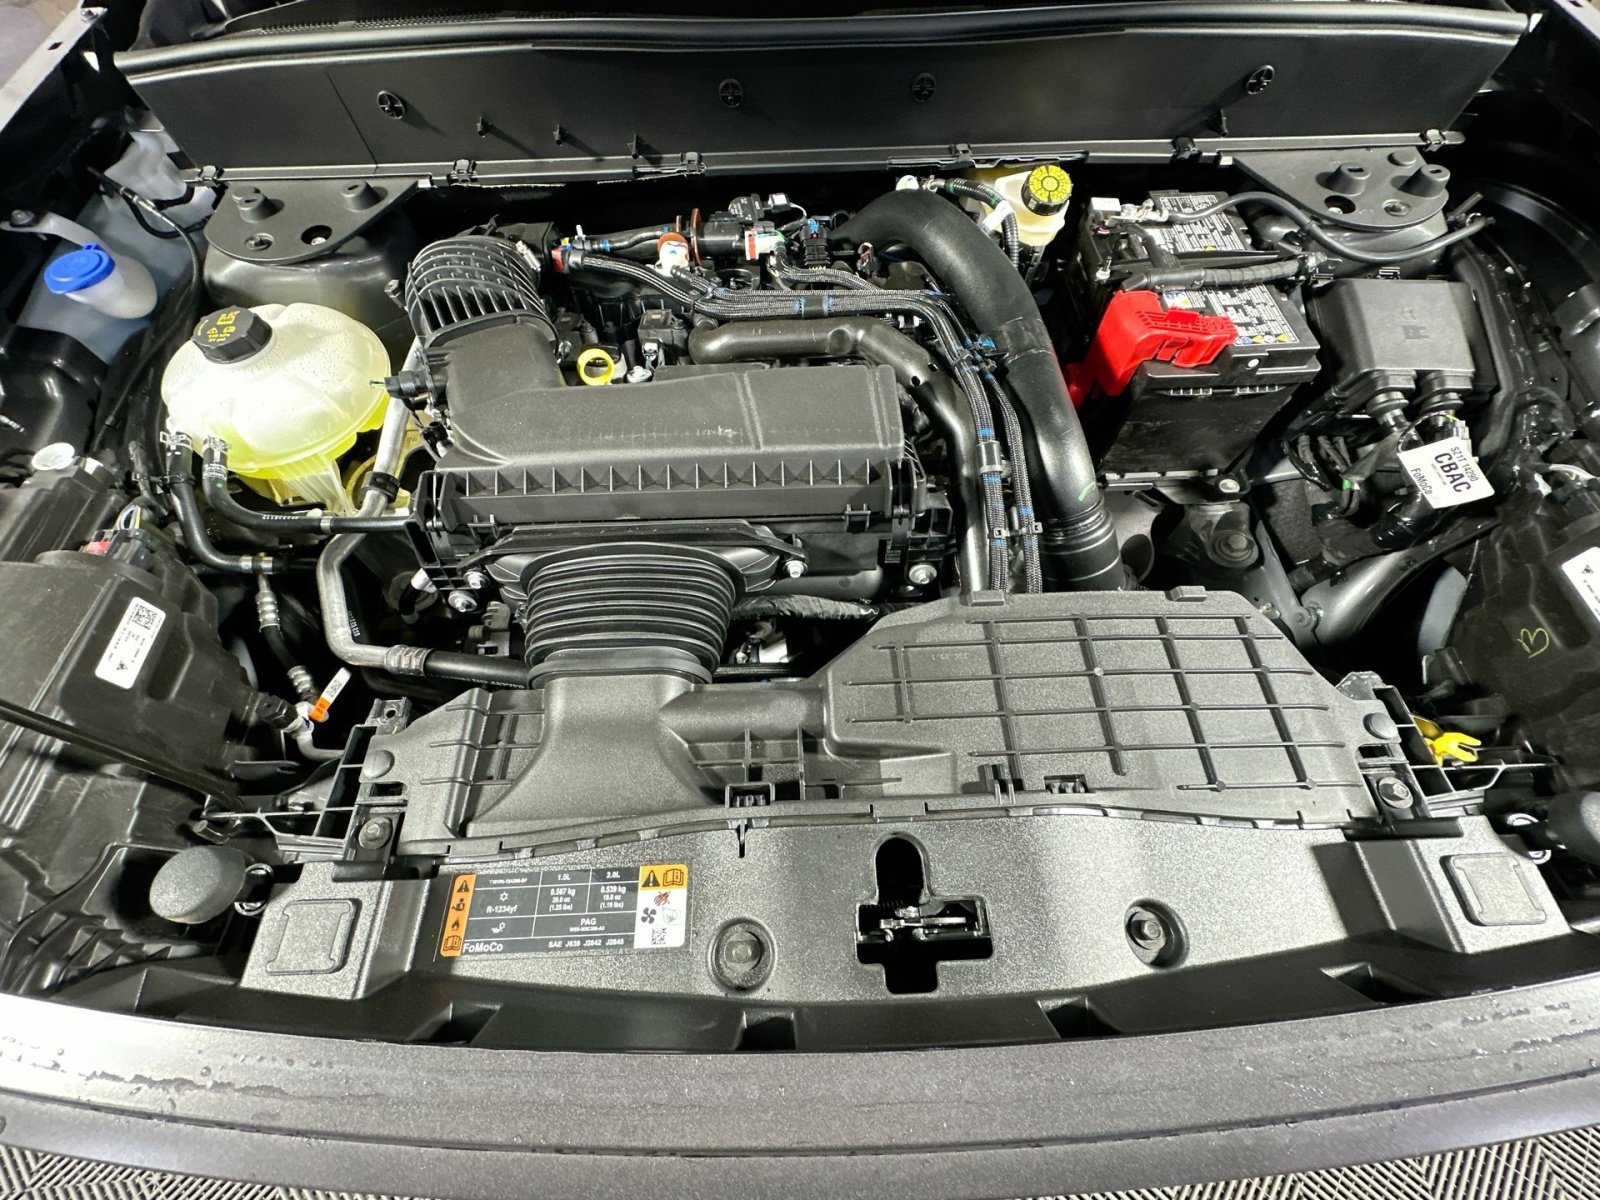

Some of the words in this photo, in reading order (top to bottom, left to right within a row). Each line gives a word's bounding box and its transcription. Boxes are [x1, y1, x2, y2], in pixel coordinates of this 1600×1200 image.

[1434, 452, 1472, 493] CBAC
[1461, 463, 1479, 482] 14290
[1410, 467, 1433, 495] FoMoCo
[557, 873, 571, 881] 1.5L
[606, 871, 621, 879] 2.0L
[618, 885, 627, 895] kg
[486, 904, 518, 914] R-1234yf
[580, 917, 597, 926] PAG
[462, 942, 504, 954] FoMoCo
[548, 941, 563, 949] SAE
